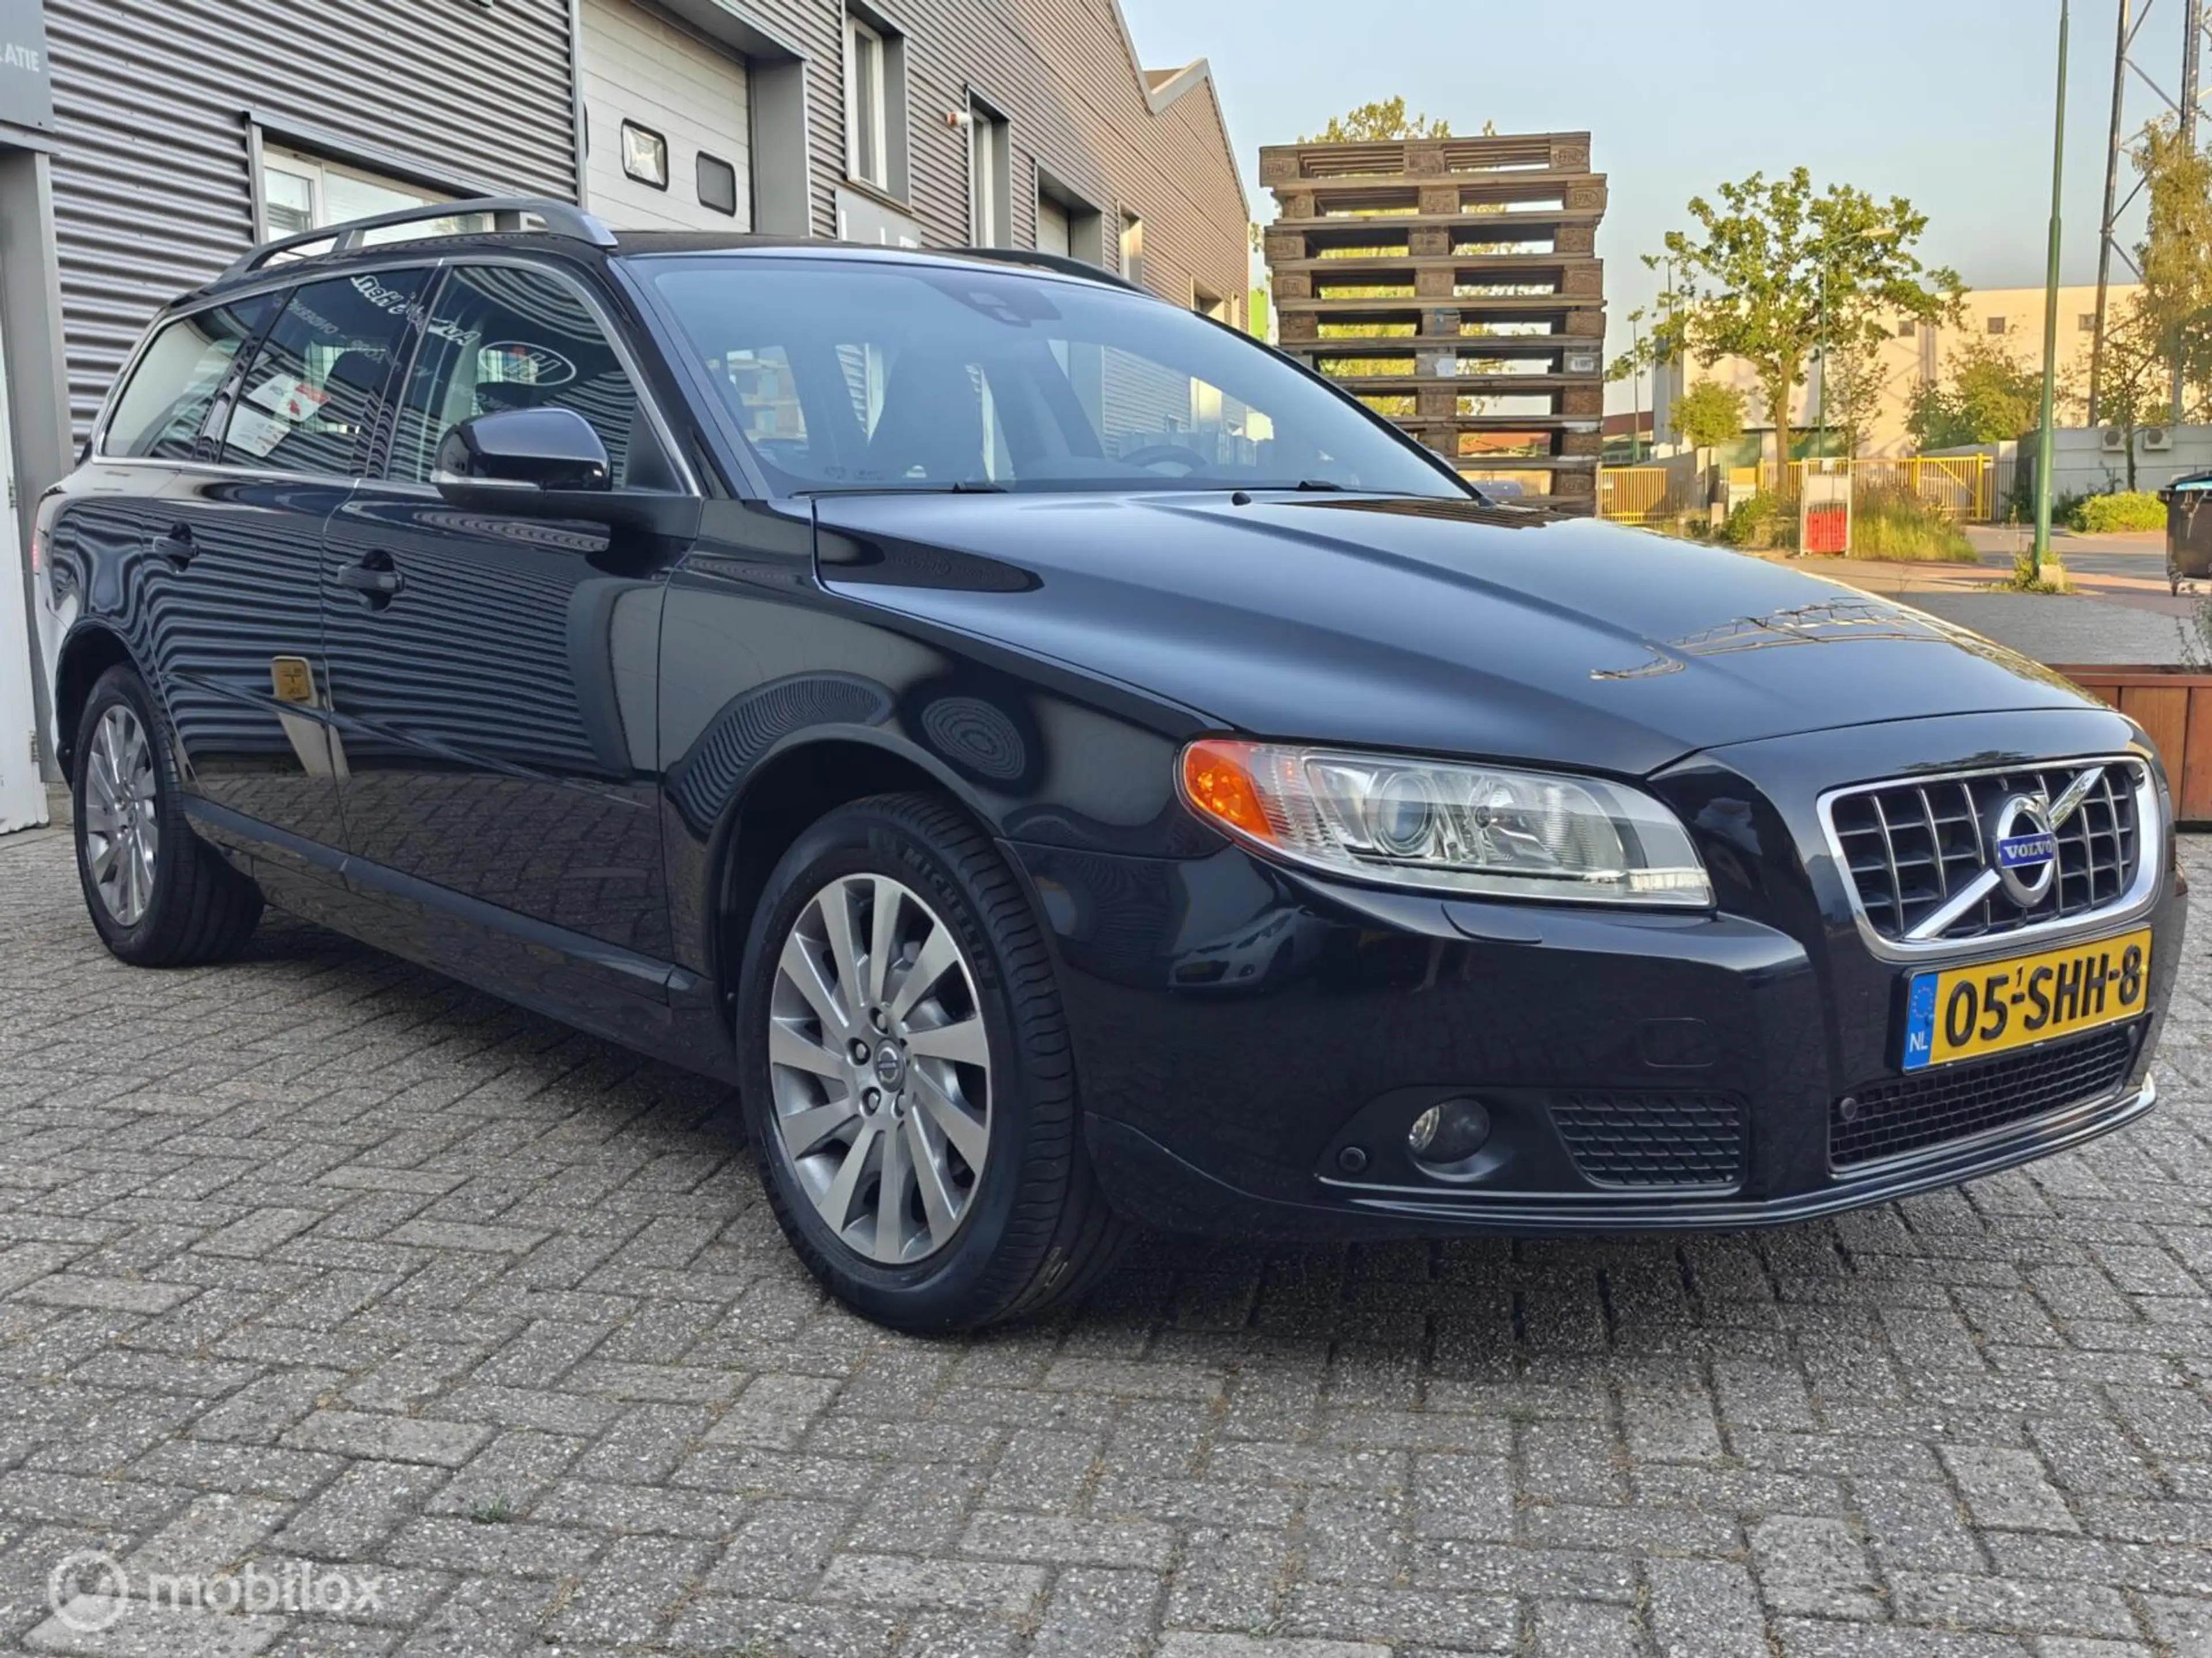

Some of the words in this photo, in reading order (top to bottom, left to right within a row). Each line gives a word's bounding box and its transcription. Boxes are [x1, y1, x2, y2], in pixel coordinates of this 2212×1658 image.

[0, 43, 40, 73] ATIE
[2003, 840, 2052, 860] VOLVO
[903, 847, 995, 980] MICHELIN
[1945, 944, 2143, 1048] 05-SHH-8
[1909, 1031, 1929, 1052] NL
